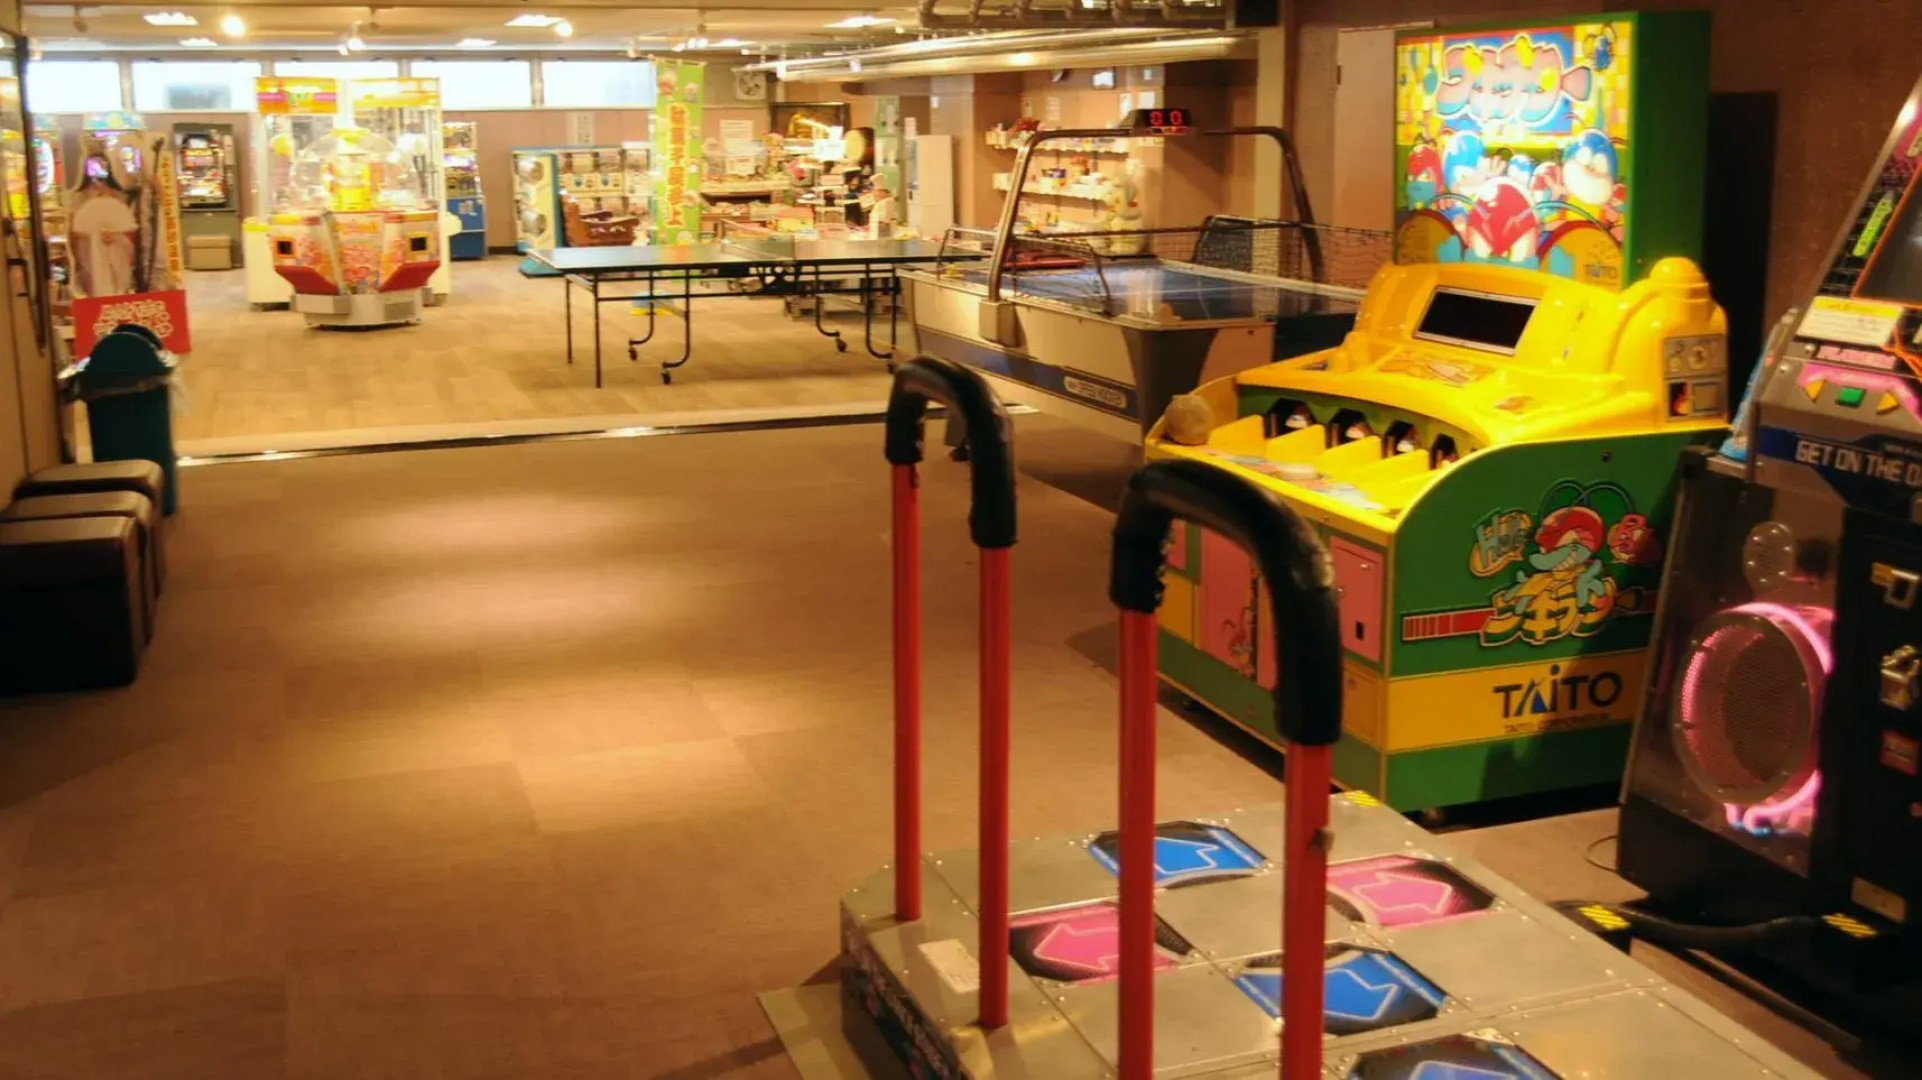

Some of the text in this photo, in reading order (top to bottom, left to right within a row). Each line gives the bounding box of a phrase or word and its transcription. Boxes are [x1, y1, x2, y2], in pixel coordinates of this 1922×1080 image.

[1796, 440, 1832, 466] GET
[1835, 448, 1862, 472] ON
[1866, 454, 1902, 482] THE
[1904, 463, 1922, 487] D
